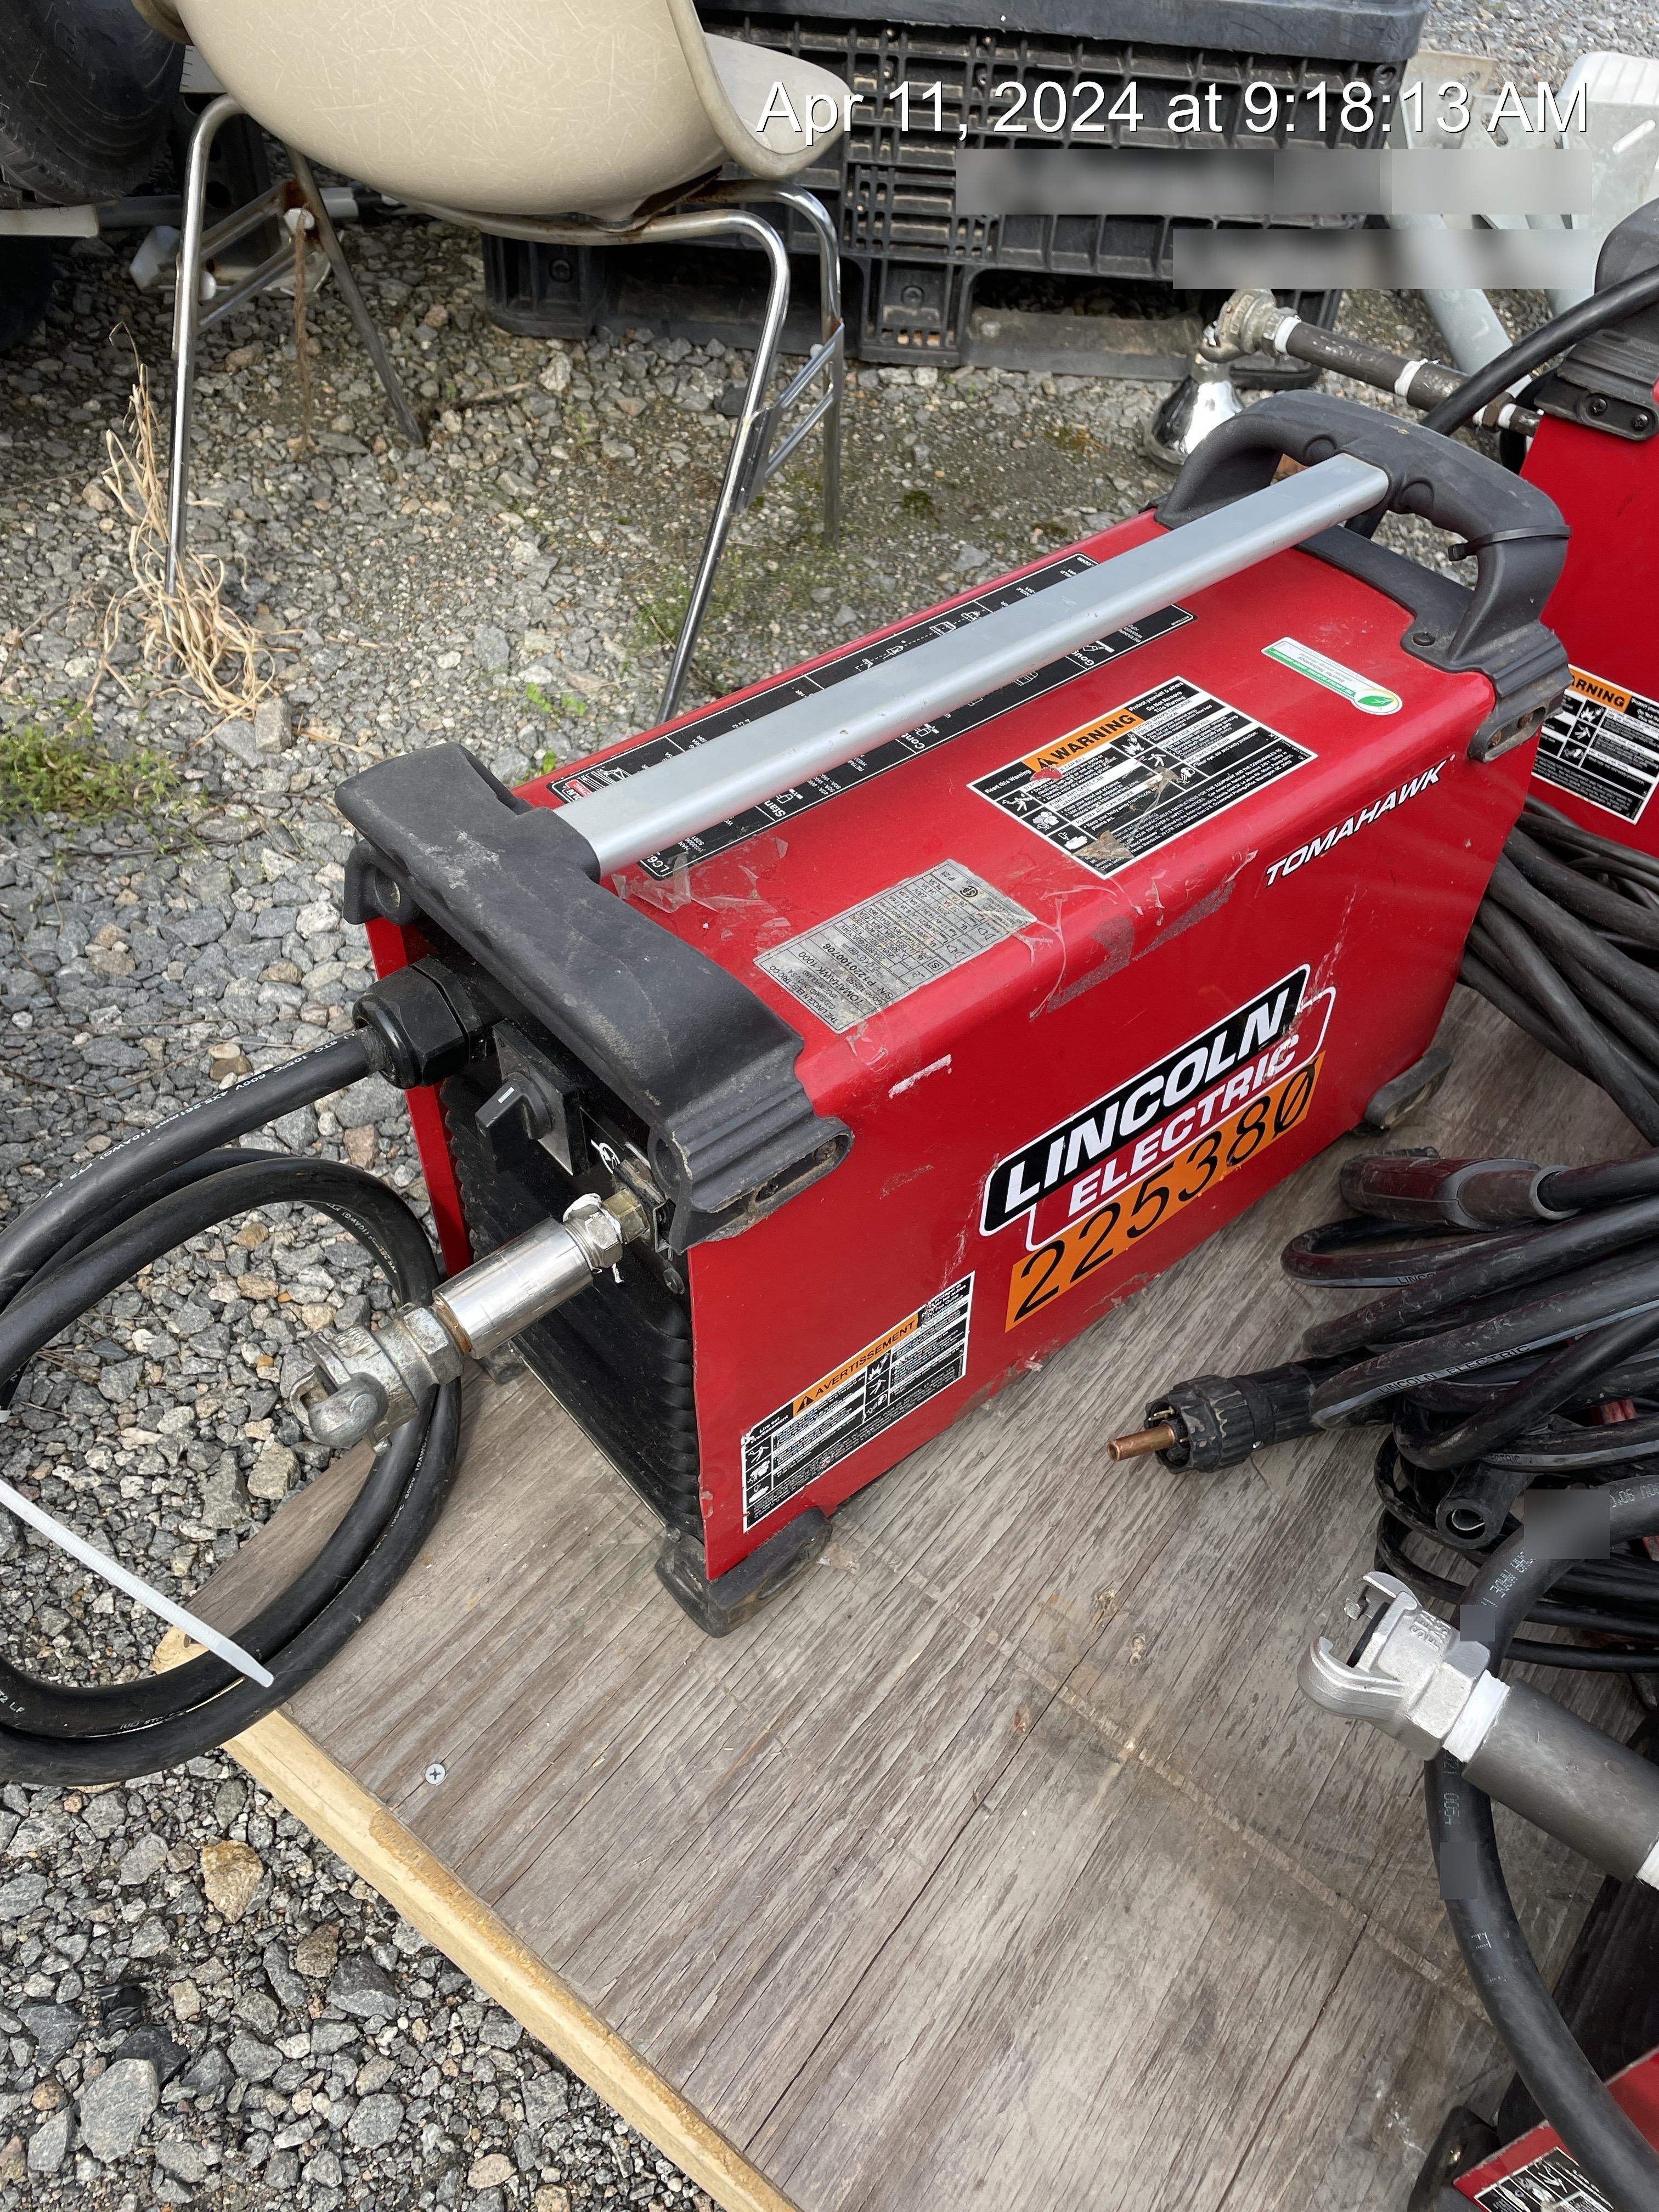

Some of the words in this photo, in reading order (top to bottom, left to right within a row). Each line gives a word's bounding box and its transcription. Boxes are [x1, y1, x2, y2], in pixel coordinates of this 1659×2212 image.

[1127, 701, 1148, 712] Protect
[1144, 691, 1166, 703] yourself
[1166, 681, 1185, 691] others
[1161, 691, 1183, 702] Remove
[1164, 695, 1187, 707] Warning
[1132, 720, 1153, 732] CUTTING
[1150, 712, 1169, 721] SPARKS
[1048, 713, 1137, 761] WARNING
[1170, 729, 1191, 741] VOLTAGE
[984, 784, 1002, 794] Read
[997, 779, 1012, 787] this
[1007, 768, 1032, 782] Warning
[1048, 795, 1067, 806] FUMES
[1076, 781, 1094, 792] GASES
[1060, 788, 1091, 805] DANGEROUS
[1075, 812, 1096, 823] PLASMA
[1115, 791, 1134, 802] INJURE
[1085, 819, 1098, 827] Keep
[1266, 760, 1447, 887] TOMAHAWK
[797, 951, 819, 968] 1000
[821, 943, 877, 986] P1220100706
[777, 972, 806, 995] ELECTRIC
[815, 966, 865, 1005] TOMAHAWK
[844, 976, 866, 992] 12850
[802, 993, 828, 1014] LINCOLN
[863, 991, 883, 1006] Code
[824, 1012, 840, 1023] THE
[314, 1039, 338, 1054] STO
[234, 1073, 267, 1092] 600V
[1005, 986, 1290, 1213] LINCOLN
[1068, 1034, 1299, 1217] ELECTRIC
[99, 1127, 151, 1160] (10AWG)
[1014, 1059, 1318, 1323] 225380
[815, 1319, 915, 1397] AVERTISSEMENT
[1378, 1370, 1437, 1395] LINCOLN
[1445, 1344, 1531, 1376] ELECTRIC
